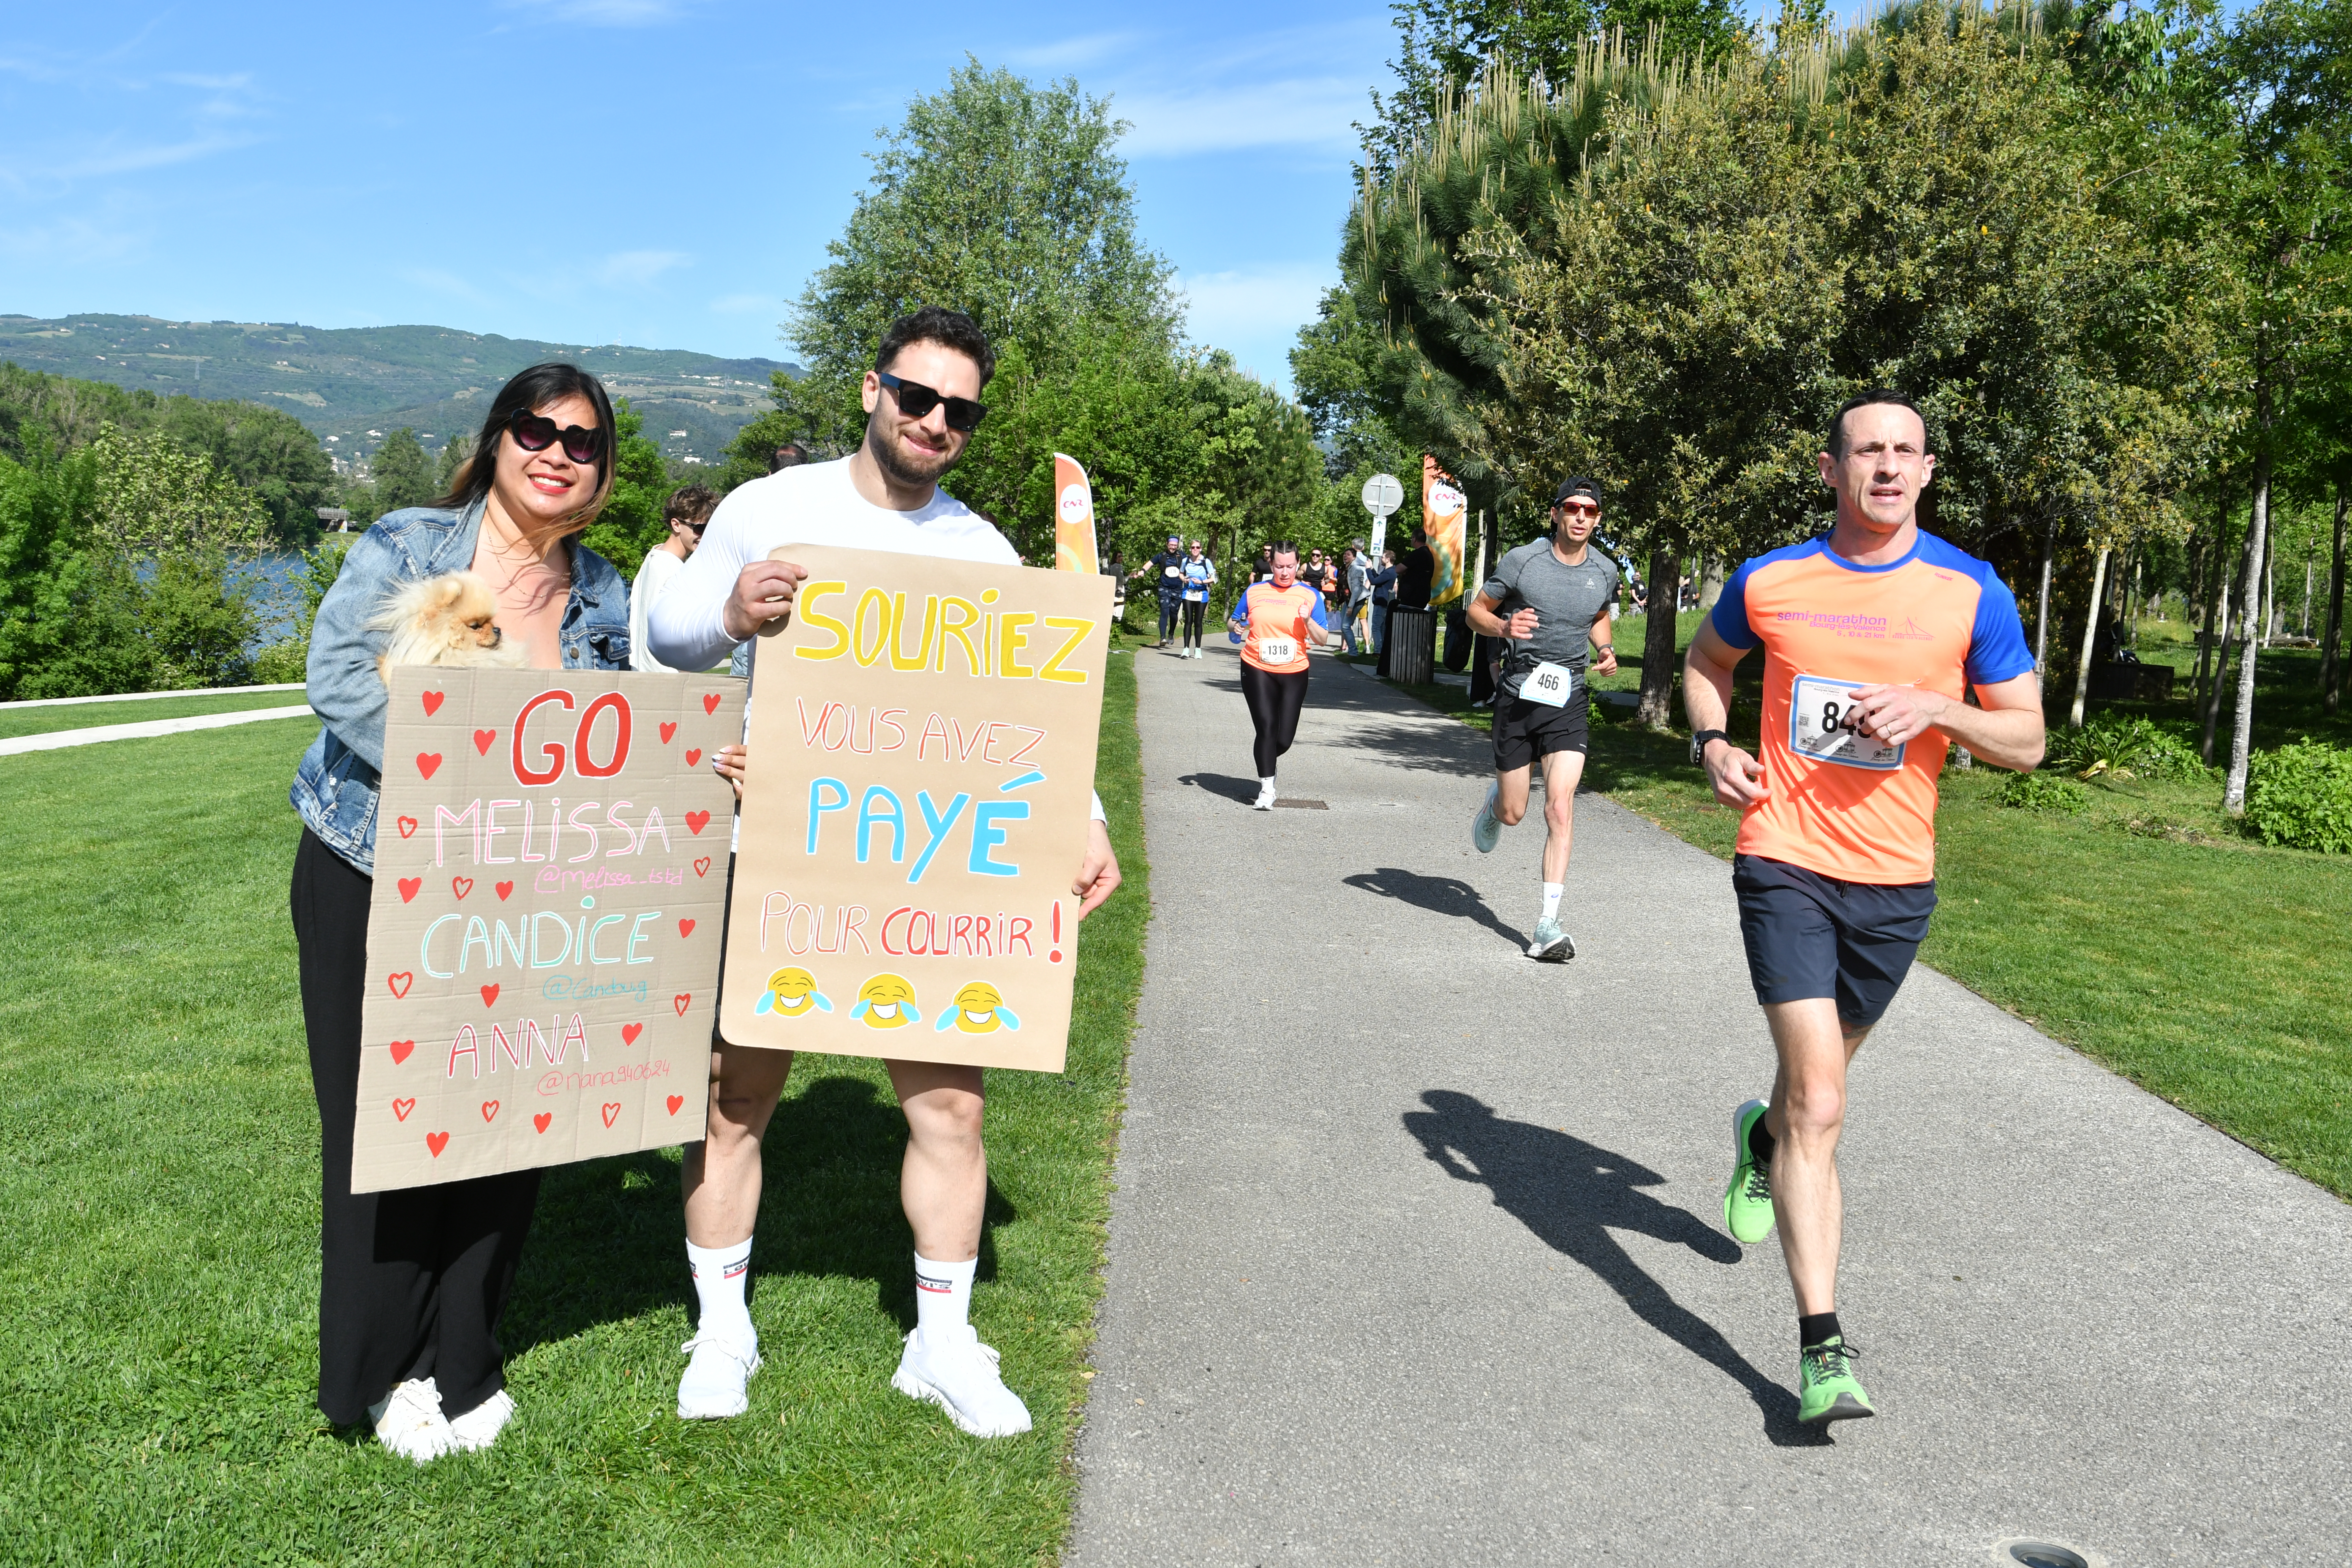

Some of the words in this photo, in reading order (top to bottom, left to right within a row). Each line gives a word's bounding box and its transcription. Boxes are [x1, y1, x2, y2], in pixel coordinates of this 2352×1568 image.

[1063, 499, 1084, 508] CNR
[1268, 645, 1288, 655] 1318
[1777, 610, 1887, 625] semi-marathon
[1537, 673, 1560, 691] 466
[510, 689, 634, 787] GO
[796, 696, 909, 755] VOUS
[917, 712, 1048, 770] AVEZ
[806, 770, 1047, 884] PAYÉ
[760, 890, 871, 957] POUR
[447, 1013, 589, 1079] ANNA
